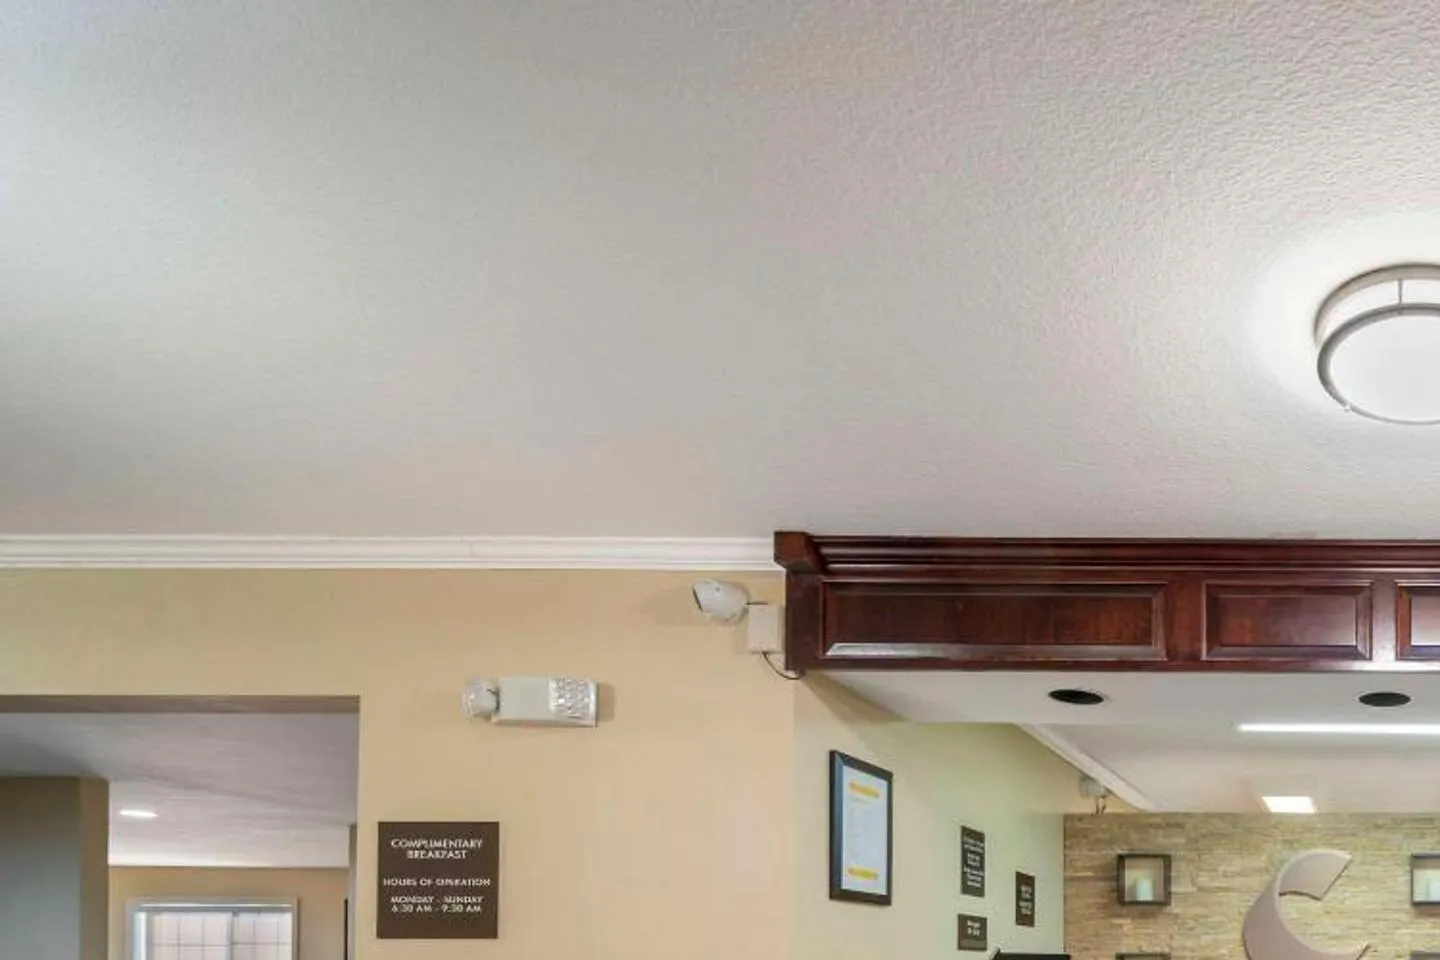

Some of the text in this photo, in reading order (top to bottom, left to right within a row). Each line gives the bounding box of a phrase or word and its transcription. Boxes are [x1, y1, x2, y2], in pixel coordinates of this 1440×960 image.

[390, 838, 483, 849] COMPLIMENTARY
[406, 849, 468, 859] BREAKFAST
[383, 877, 491, 887] HOURS OF OPERATION
[390, 895, 435, 904] MONDAY
[443, 895, 484, 904] SUNDAY
